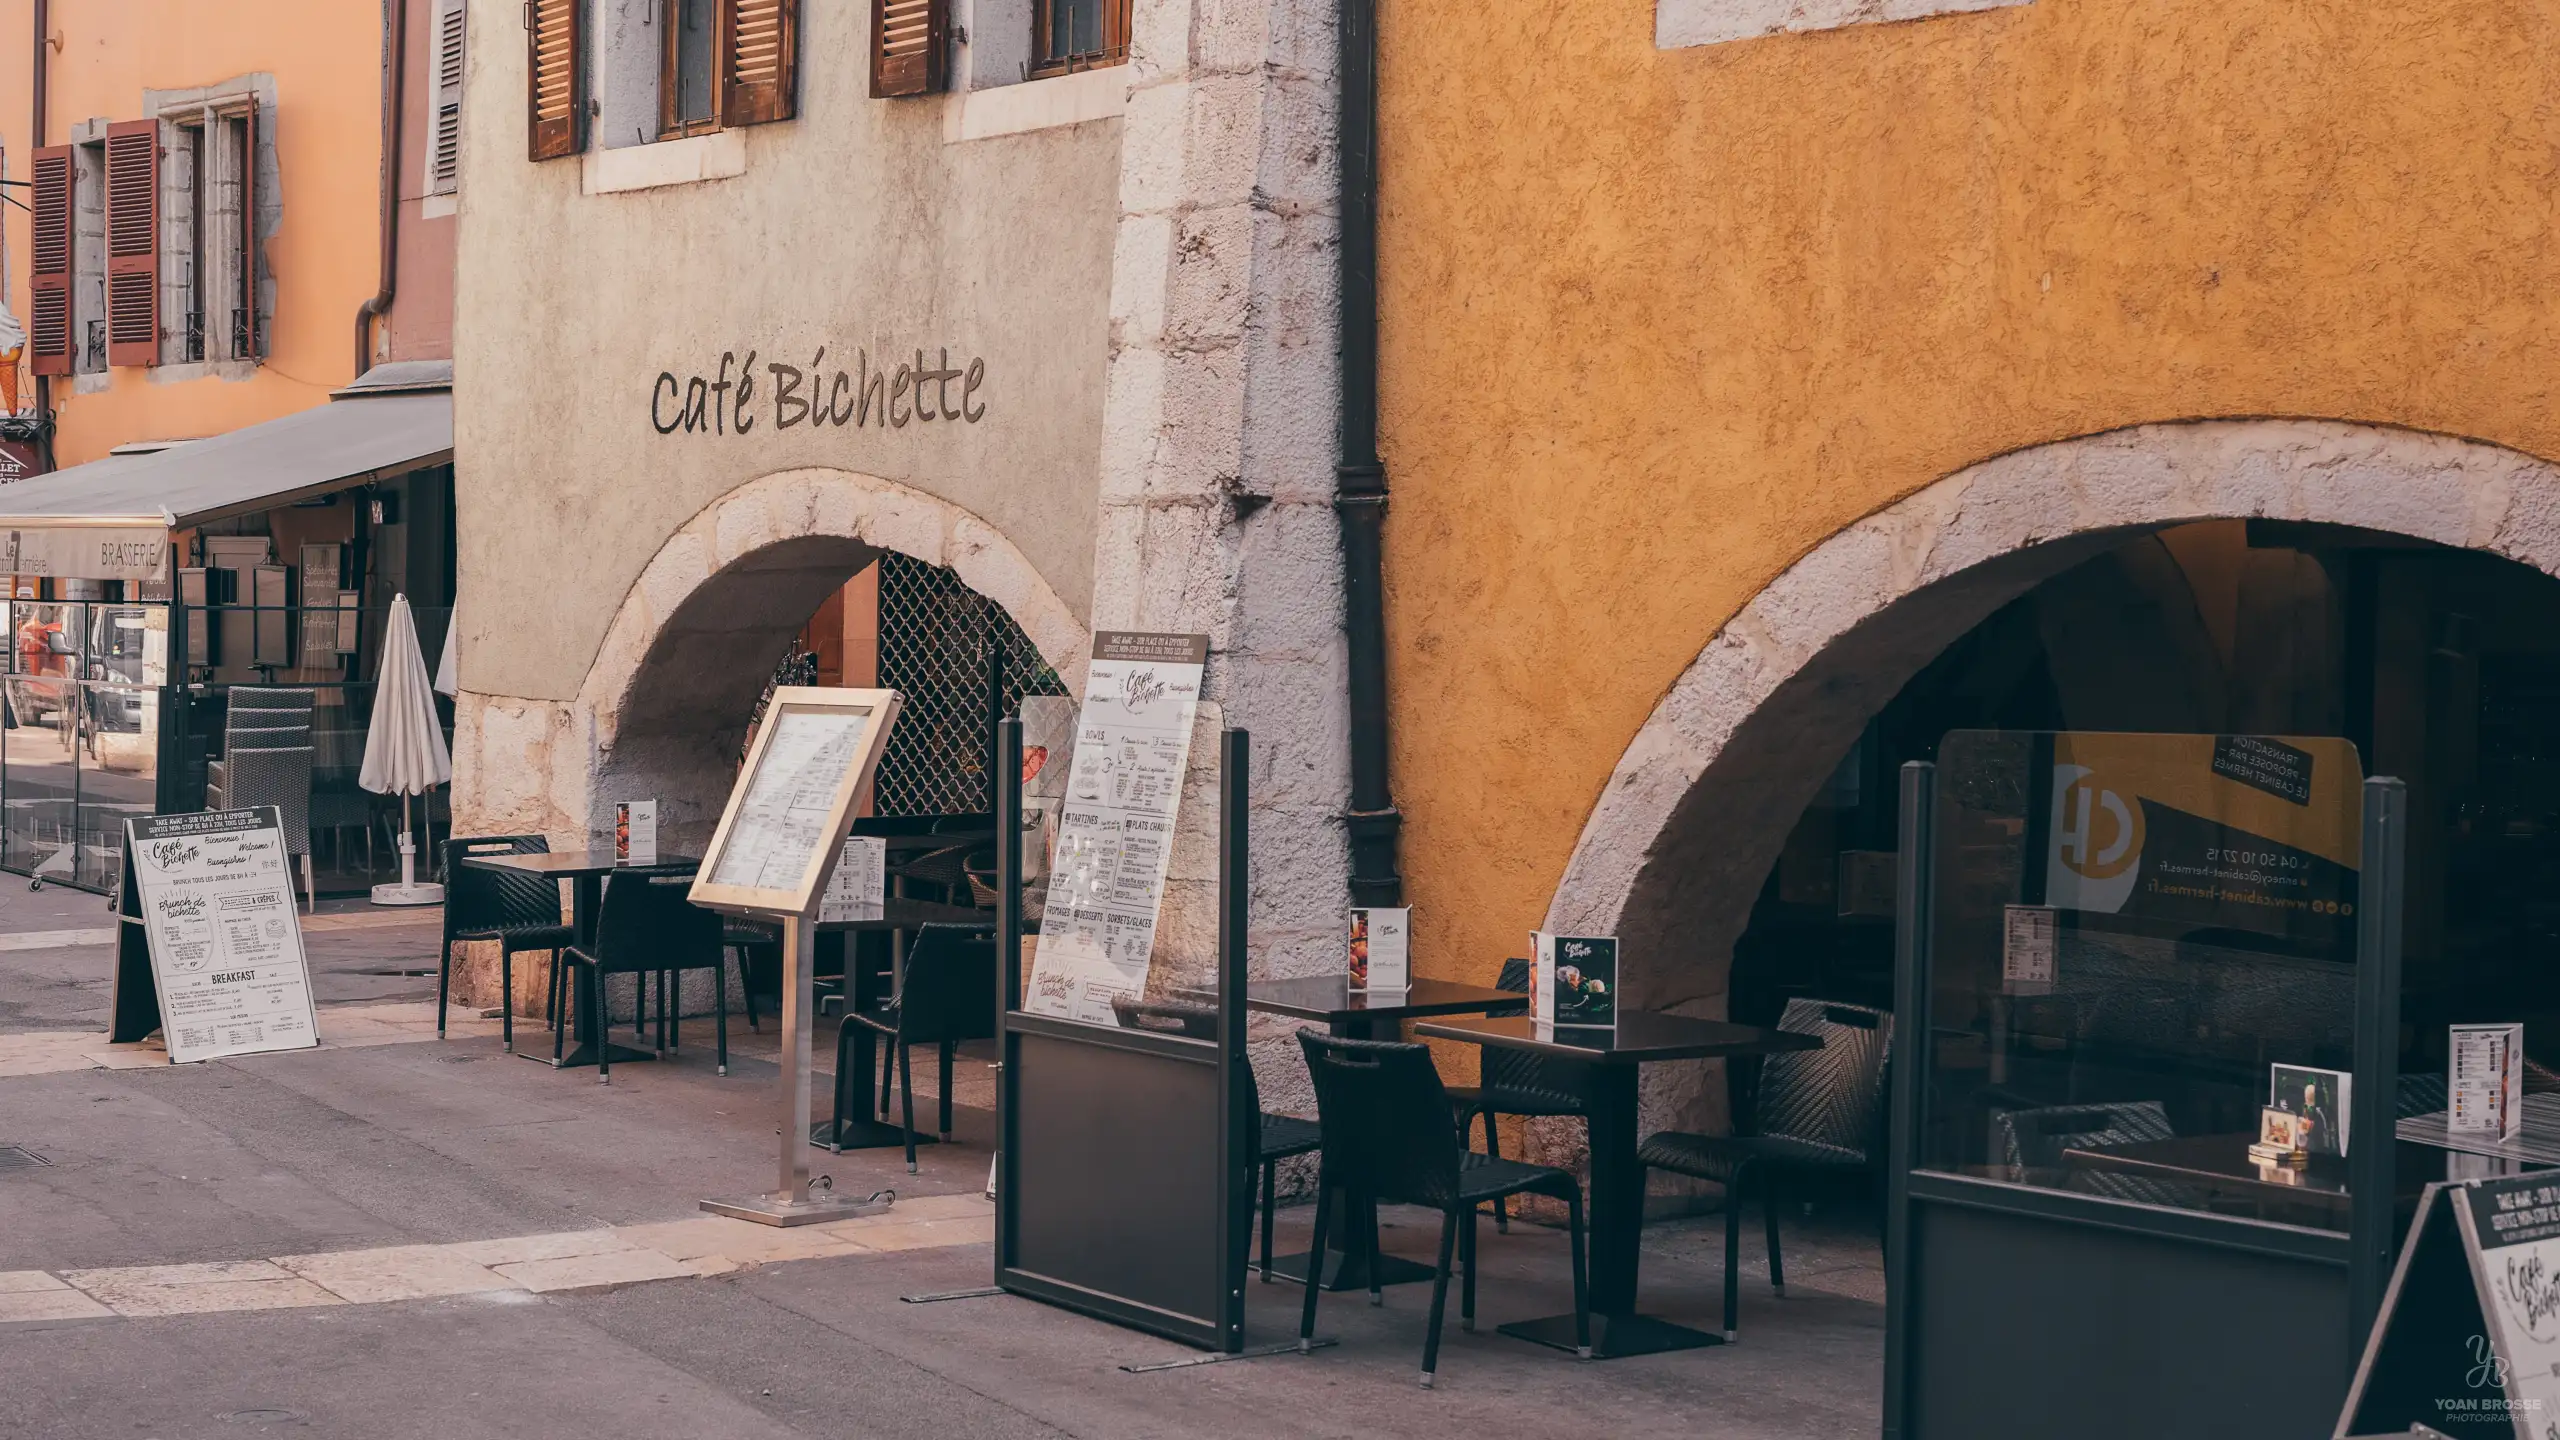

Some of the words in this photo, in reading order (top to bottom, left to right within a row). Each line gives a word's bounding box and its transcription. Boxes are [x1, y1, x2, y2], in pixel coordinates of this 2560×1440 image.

[651, 350, 756, 436] Café
[101, 542, 158, 567] BRASSERIE
[1126, 667, 1155, 693] Café
[1128, 681, 1165, 707] Bichette
[169, 817, 183, 825] AWAY
[188, 816, 199, 824] SUR
[199, 814, 214, 823] PLACE
[229, 811, 254, 820] EMPORTER
[1071, 813, 1098, 825] TARTINES
[149, 825, 168, 834] SERVICE
[225, 819, 237, 827] TOUS
[238, 818, 246, 826] LES
[1132, 820, 1148, 832] PLATS
[204, 835, 239, 844] Bienvenue
[238, 842, 269, 852] Welcome
[152, 838, 183, 859] Café
[162, 845, 200, 869] Bichette
[159, 896, 192, 911] Brunch
[193, 896, 206, 907] de
[1046, 905, 1071, 917] FROMAGES
[168, 906, 200, 918] bichette
[1080, 910, 1103, 922] DESSERTS
[1107, 913, 1152, 929] SORBETS/GLACES
[211, 970, 256, 985] BREAKFAST
[2507, 1246, 2544, 1302] Café
